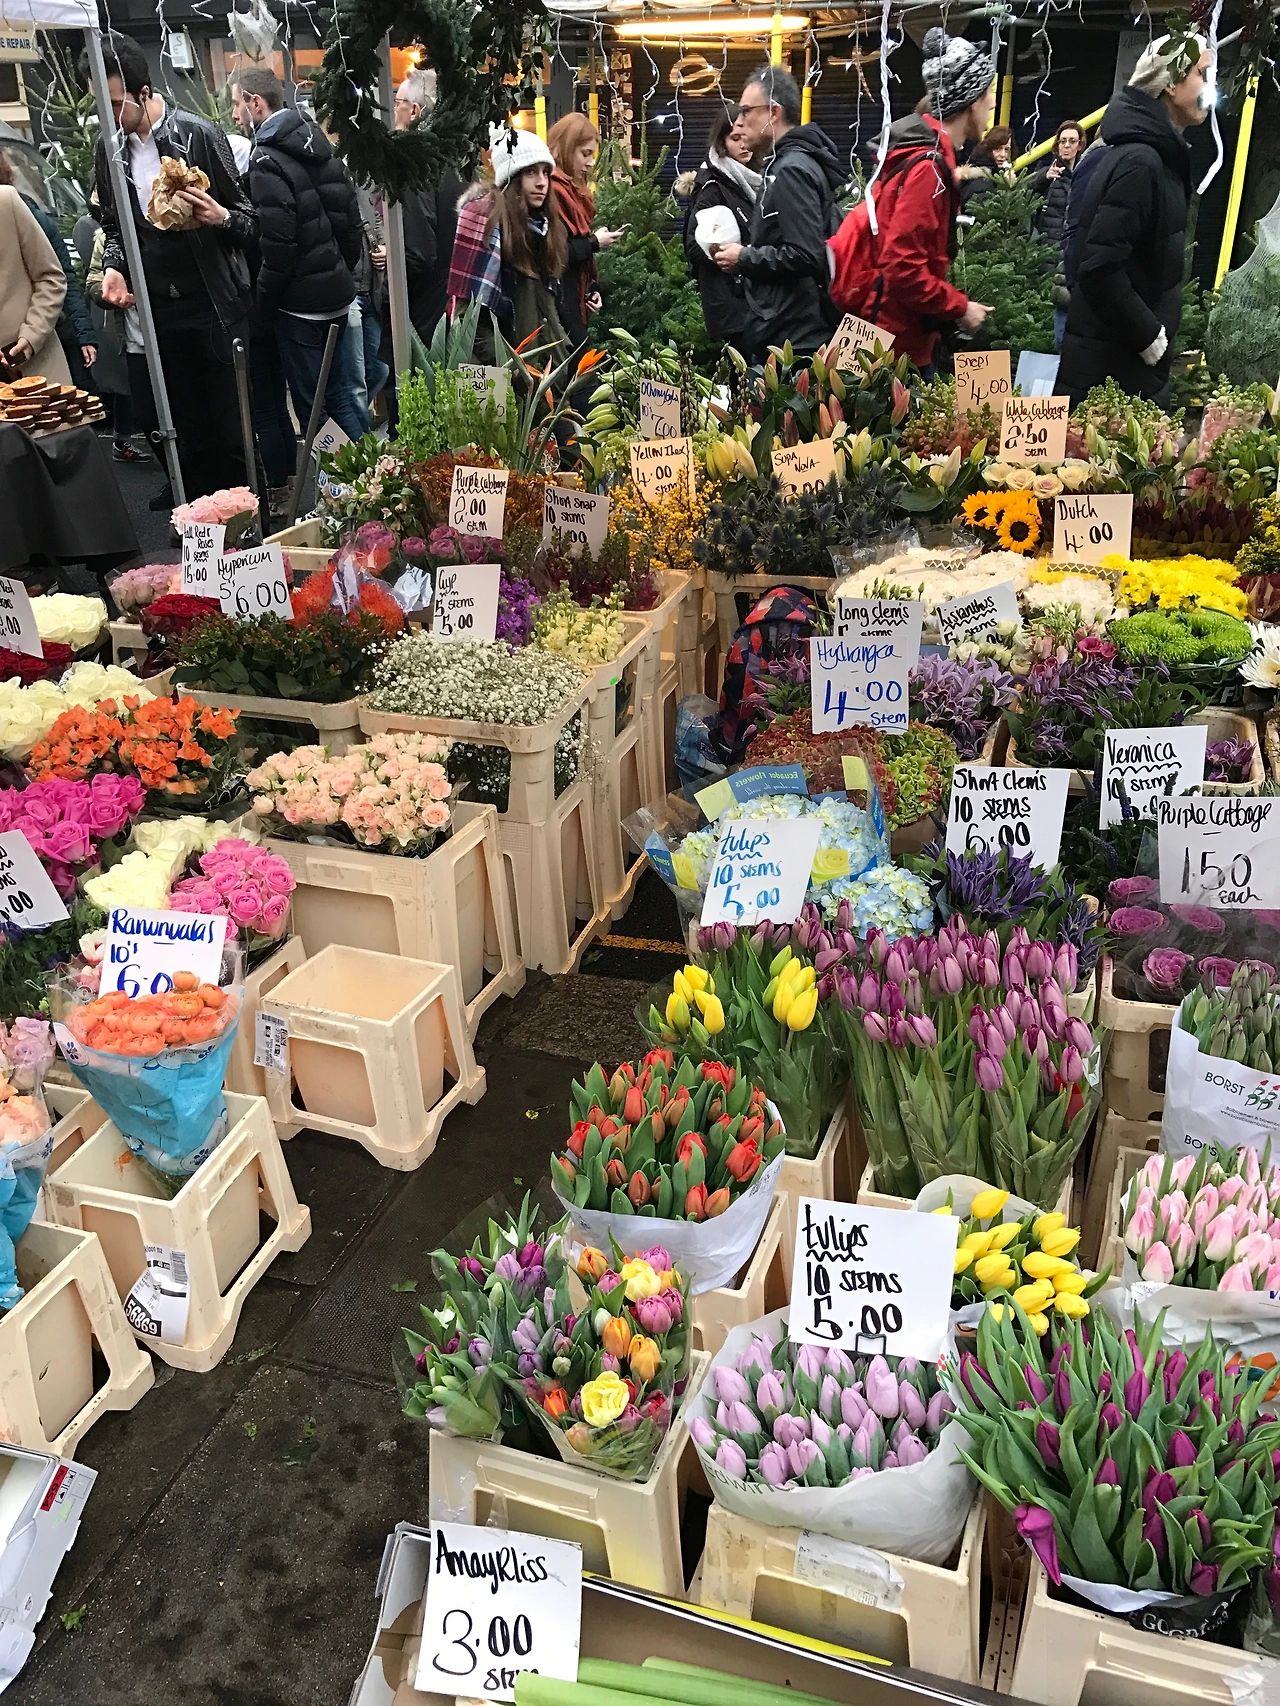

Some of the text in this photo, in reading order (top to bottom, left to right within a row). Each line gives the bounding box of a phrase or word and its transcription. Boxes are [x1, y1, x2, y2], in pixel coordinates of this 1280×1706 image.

[7, 38, 31, 49] REPAIR
[971, 378, 1009, 405] 4.00
[1005, 423, 1048, 449] 2.50
[636, 465, 672, 488] 4.00
[454, 496, 487, 525] 2.00
[545, 504, 556, 524] 10
[1057, 495, 1098, 520] Dutch
[1064, 522, 1113, 553] 4.00
[184, 545, 190, 562] 10
[184, 563, 208, 584] 15.00
[235, 580, 288, 614] 6.00
[434, 599, 445, 618] 5
[439, 613, 474, 636] 5.00
[824, 680, 903, 725] 4.00
[1106, 735, 1178, 766] Veronica
[955, 795, 974, 823] 10
[1158, 800, 1208, 828] Purple
[966, 821, 1031, 851] 6.00
[713, 863, 734, 888] 10
[1181, 847, 1252, 893] 1.50
[719, 883, 780, 920] 5.00
[1204, 1071, 1246, 1096] BORST
[806, 1261, 831, 1297] 10
[125, 1299, 158, 1335] 56869
[805, 1295, 903, 1341] 5.00
[432, 1609, 533, 1676] 3.00
